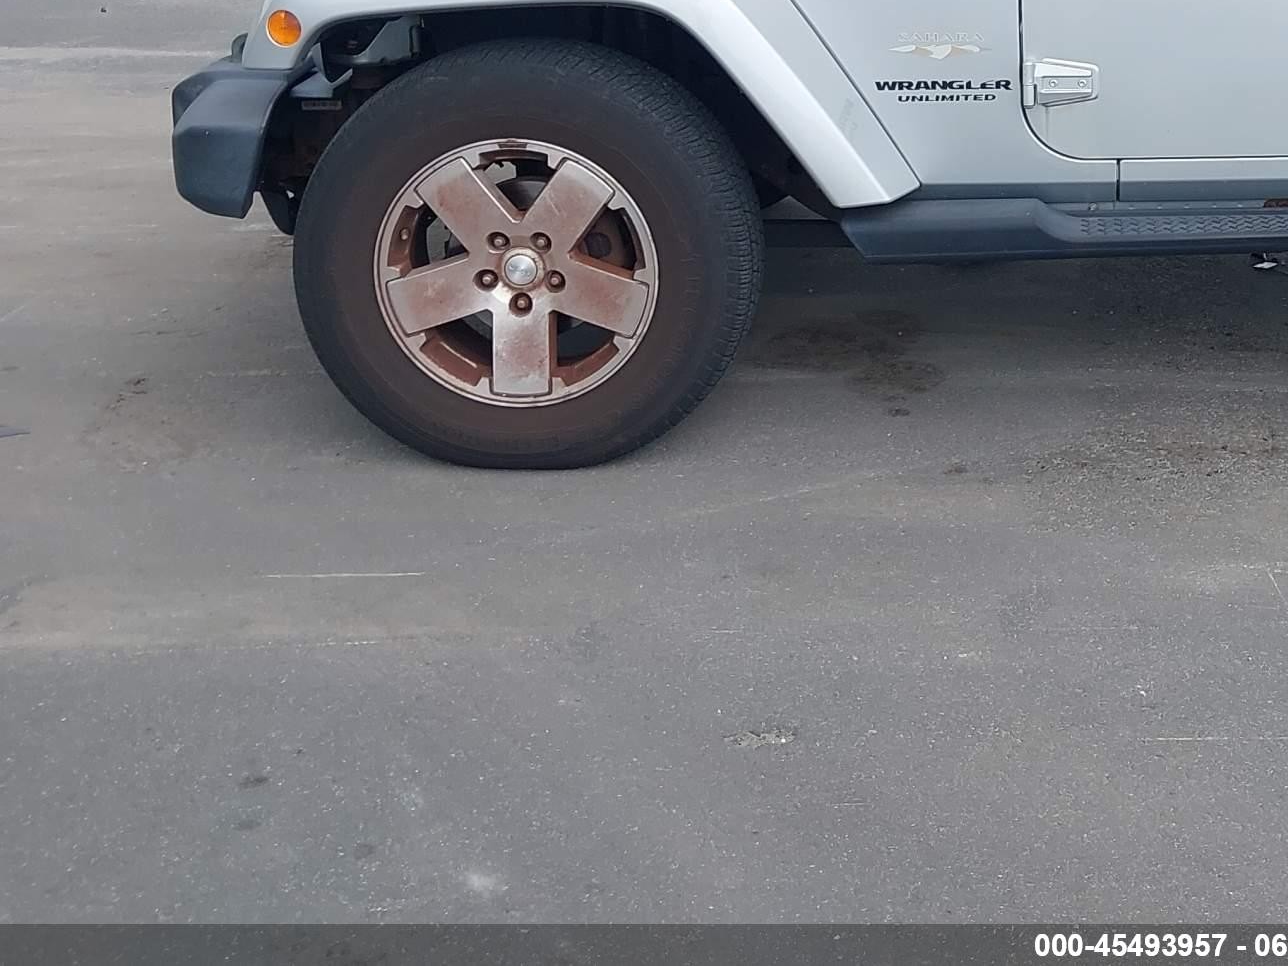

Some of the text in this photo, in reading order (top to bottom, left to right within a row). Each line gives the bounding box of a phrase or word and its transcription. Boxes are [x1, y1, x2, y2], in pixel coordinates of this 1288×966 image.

[898, 32, 985, 43] SAHARA
[875, 79, 1012, 91] WRANGLER
[897, 93, 997, 103] UNLIMITED
